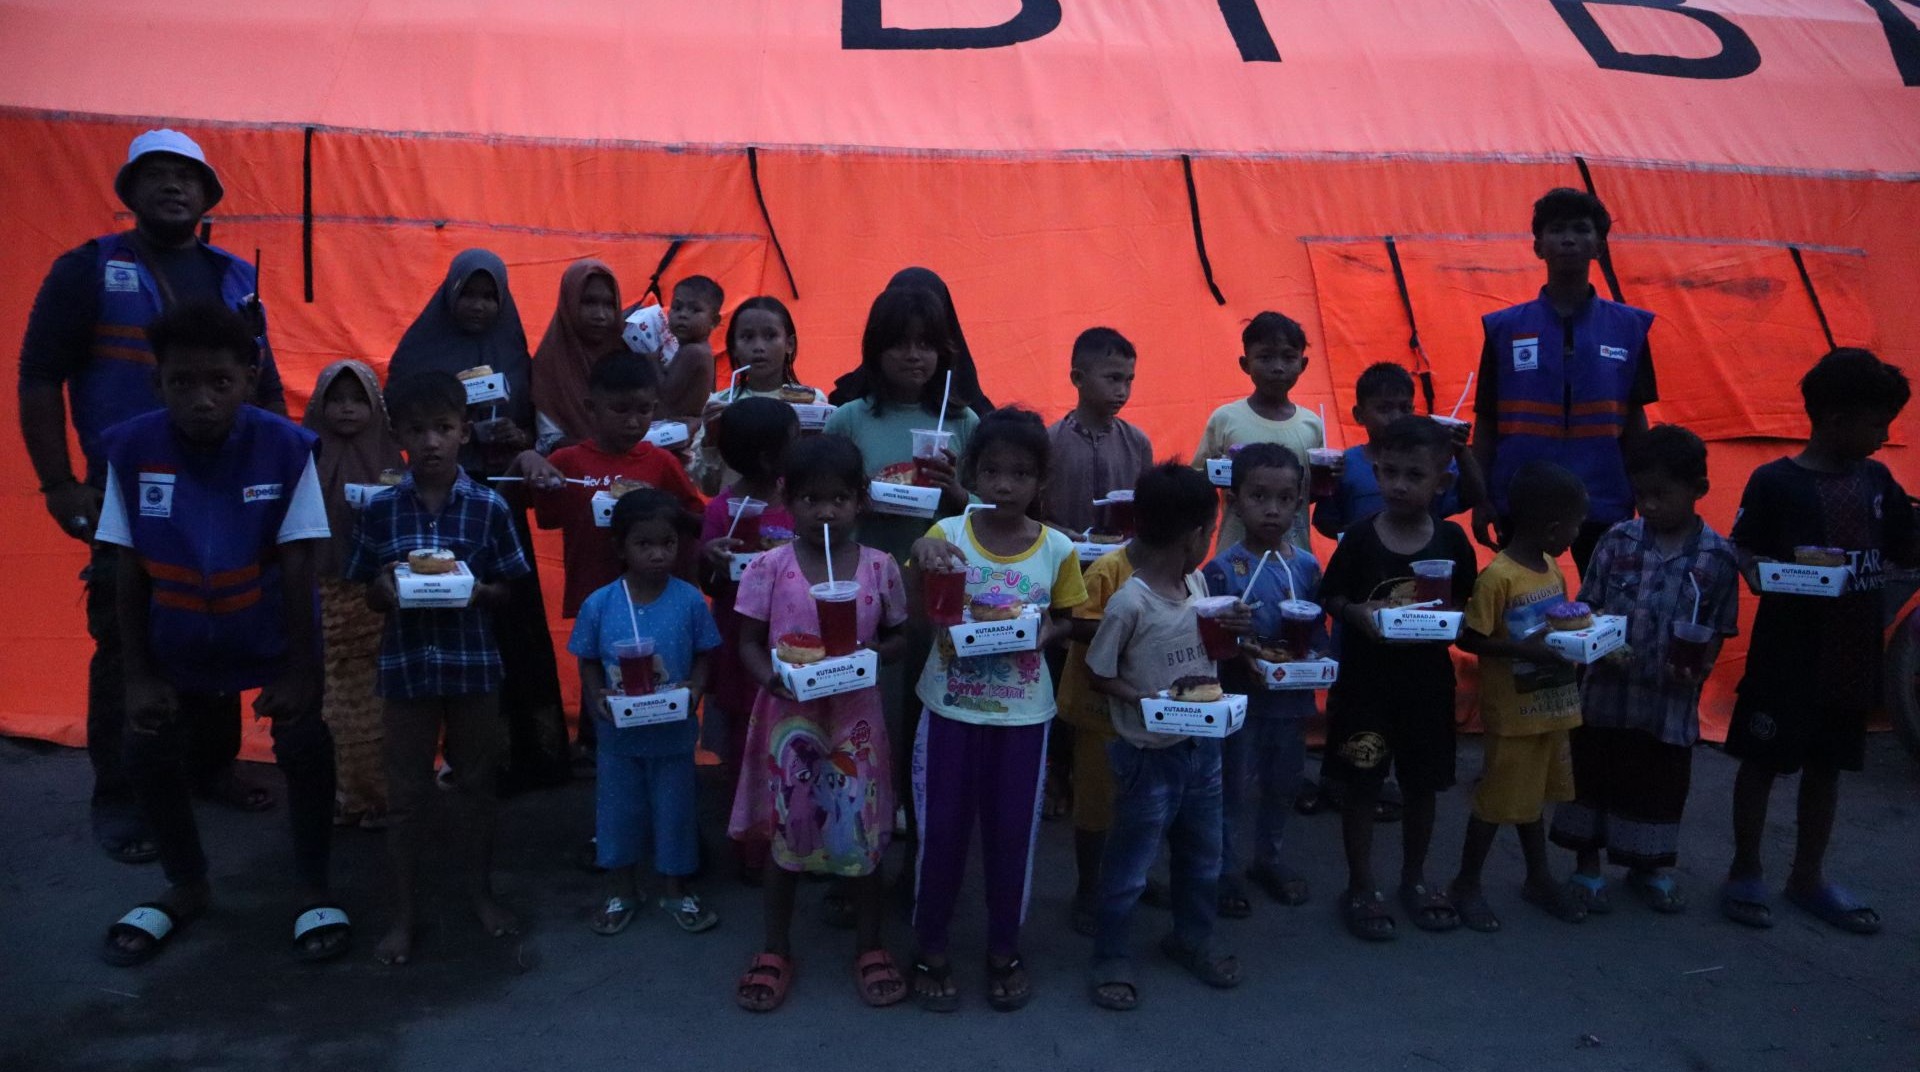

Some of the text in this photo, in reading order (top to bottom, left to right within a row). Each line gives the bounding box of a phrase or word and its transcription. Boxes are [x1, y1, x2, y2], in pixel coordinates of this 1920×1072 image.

[975, 625, 1014, 635] KUTARADJA
[816, 663, 854, 677] KUTARADJA
[632, 698, 667, 708] KUTARADJA
[1163, 706, 1202, 714] KUTARADJA
